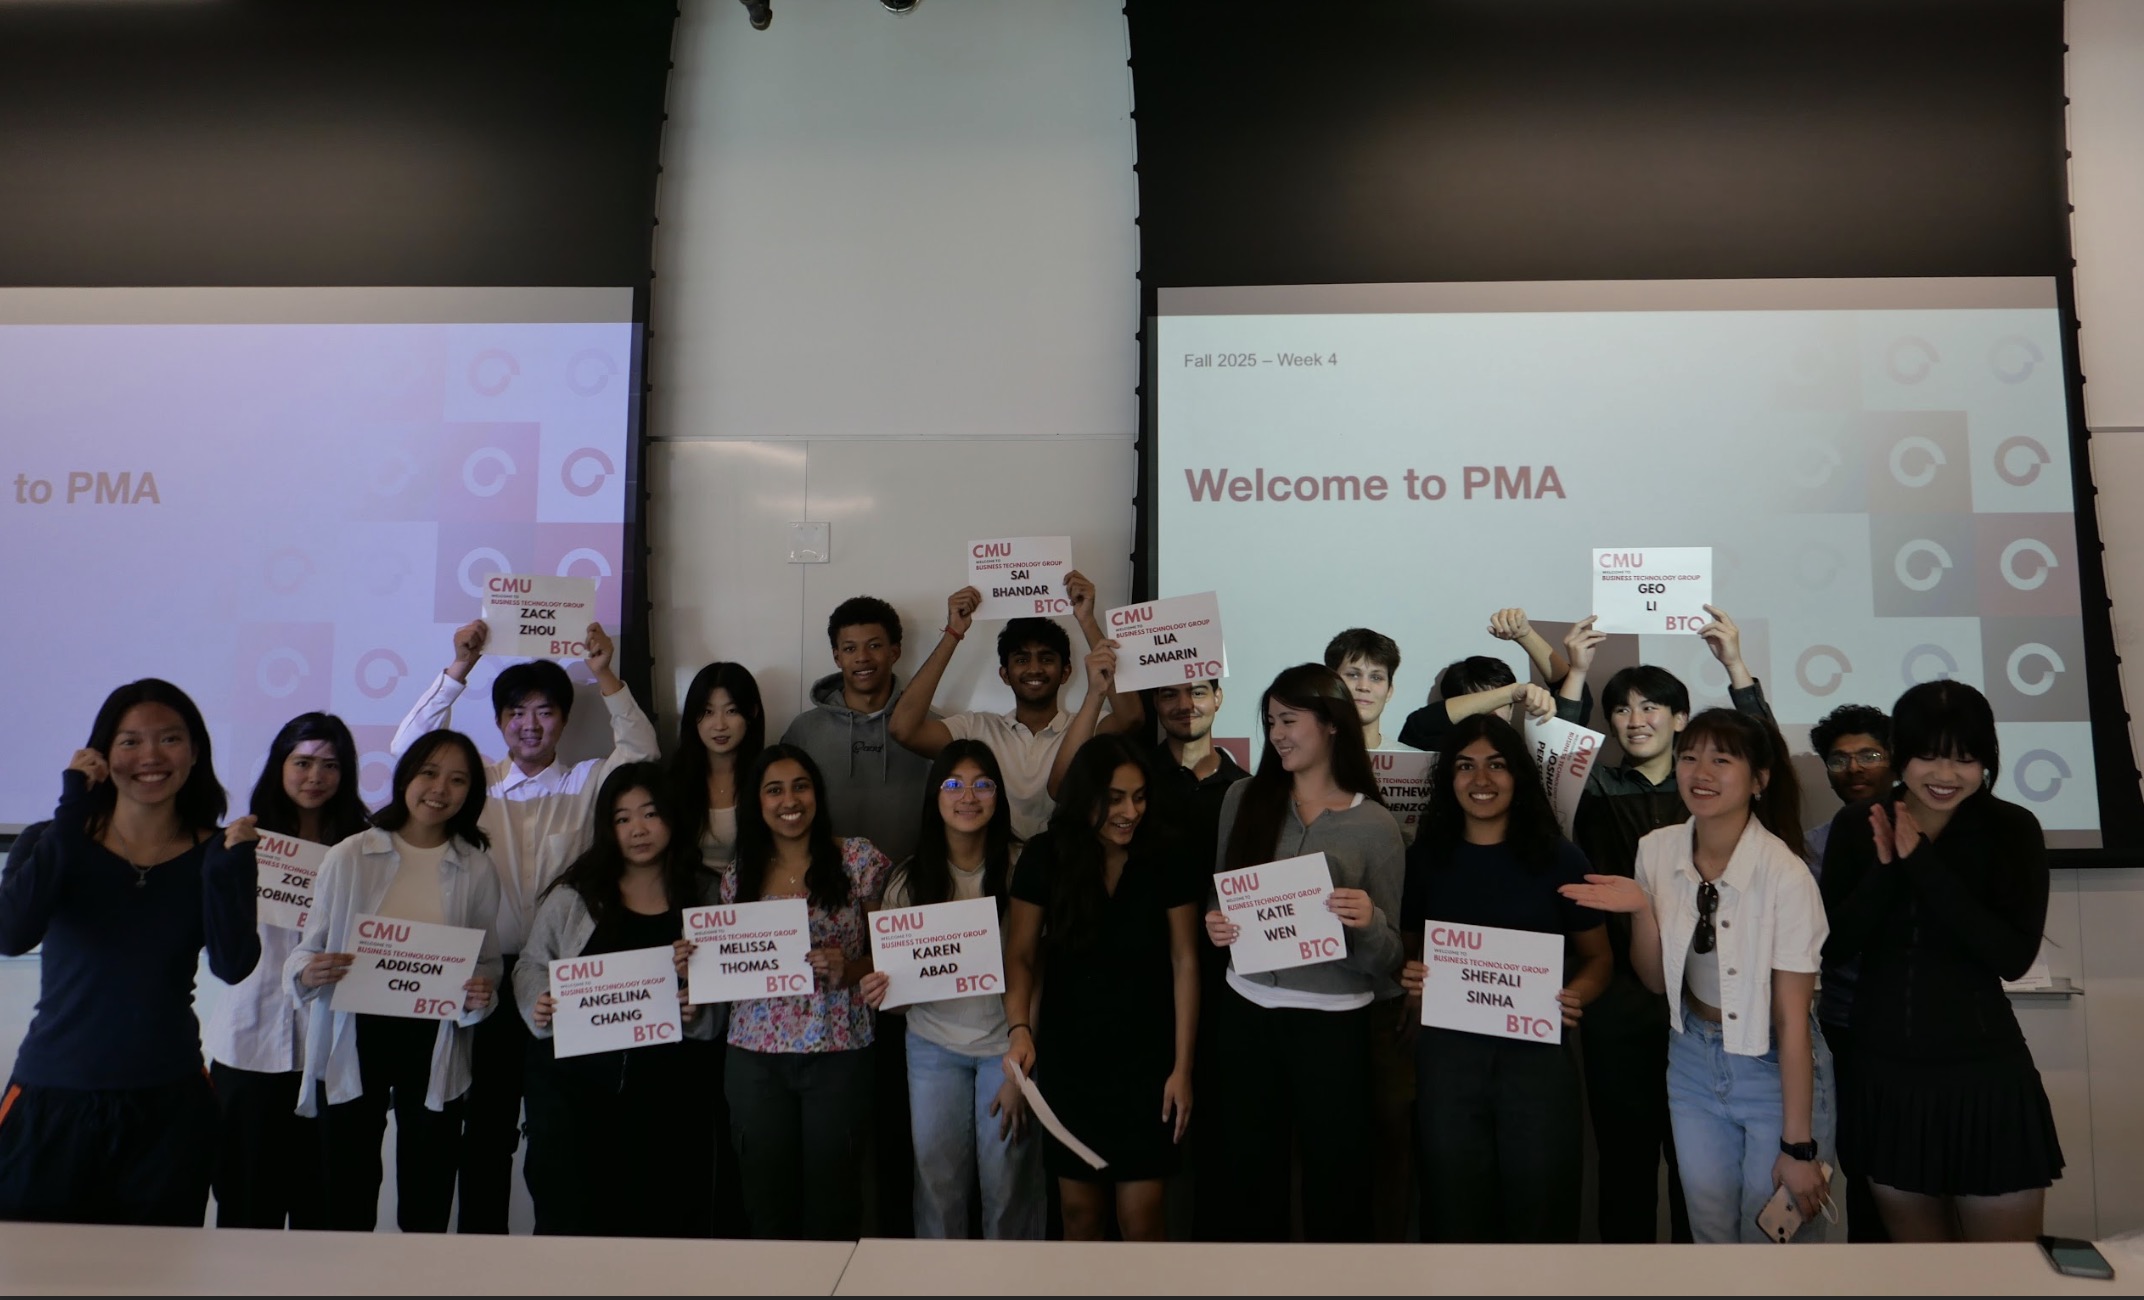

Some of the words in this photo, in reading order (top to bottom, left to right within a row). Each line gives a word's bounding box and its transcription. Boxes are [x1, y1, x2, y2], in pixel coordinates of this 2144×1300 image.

[1184, 353, 1212, 367] Fall
[1217, 353, 1257, 367] 2025
[1277, 352, 1323, 367] Week
[1328, 352, 1338, 366] 4
[13, 473, 53, 504] to
[66, 471, 161, 504] PMA
[1184, 468, 1389, 502] Welcome
[1403, 468, 1446, 501] to
[1463, 465, 1566, 500] PMA
[972, 542, 1011, 558] CMU
[976, 563, 1002, 571] BUSINESS
[1003, 561, 1041, 569] TECHNOLOGY
[1599, 552, 1644, 568] CMU
[1010, 570, 1030, 580] SAI
[489, 577, 532, 593] CMU
[992, 585, 1049, 598] BHANDAR
[1638, 583, 1666, 594] GEO
[520, 608, 556, 620] ZACK
[1646, 601, 1657, 611] LI
[1111, 606, 1154, 626] CMU
[519, 625, 556, 635] ZHOU
[1116, 629, 1146, 639] BUSINESS
[1146, 623, 1187, 634] TECHNOLOGY
[1188, 619, 1210, 628] GROUP
[1153, 633, 1178, 646] ILIA
[1139, 647, 1198, 666] SAMARIN
[1570, 735, 1596, 779] CMU
[1546, 749, 1558, 797] JOSHUA
[281, 873, 311, 889] ZOE
[1220, 872, 1260, 896] CMU
[1227, 900, 1254, 911] BUSINESS
[1255, 892, 1297, 907] TECHNOLOGY
[1298, 887, 1322, 898] GROUP
[689, 910, 737, 929] CMU
[1256, 903, 1295, 922] KATIE
[358, 920, 411, 943] CMU
[875, 912, 924, 934] CMU
[695, 933, 727, 944] BUSINESS
[728, 930, 772, 941] TECHNOLOGY
[773, 928, 798, 937] GROUP
[881, 939, 914, 949] BUSINESS
[915, 933, 962, 945] TECHNOLOGY
[963, 929, 988, 938] GROUP
[1264, 925, 1297, 941] WEN
[1430, 927, 1482, 950] CMU
[357, 946, 392, 956] BUSINESS
[393, 950, 440, 960] TECHNOLOGY
[441, 955, 466, 964] GROUP
[720, 940, 777, 955] MELISSA
[912, 942, 961, 960] KAREN
[375, 958, 444, 976] ADDISON
[556, 960, 604, 982] CMU
[720, 959, 779, 975] THOMAS
[919, 963, 958, 978] ABAD
[1433, 954, 1468, 965] BUSINESS
[1470, 959, 1520, 971] TECHNOLOGY
[1521, 966, 1549, 974] GROUP
[388, 979, 421, 992] CHO
[560, 986, 593, 997] BUSINESS
[594, 980, 640, 992] TECHNOLOGY
[641, 977, 666, 986] GROUP
[1461, 968, 1522, 988] SHEFALI
[579, 988, 651, 1008] ANGELINA
[1466, 990, 1515, 1009] SINHA
[590, 1009, 643, 1026] CHANG
